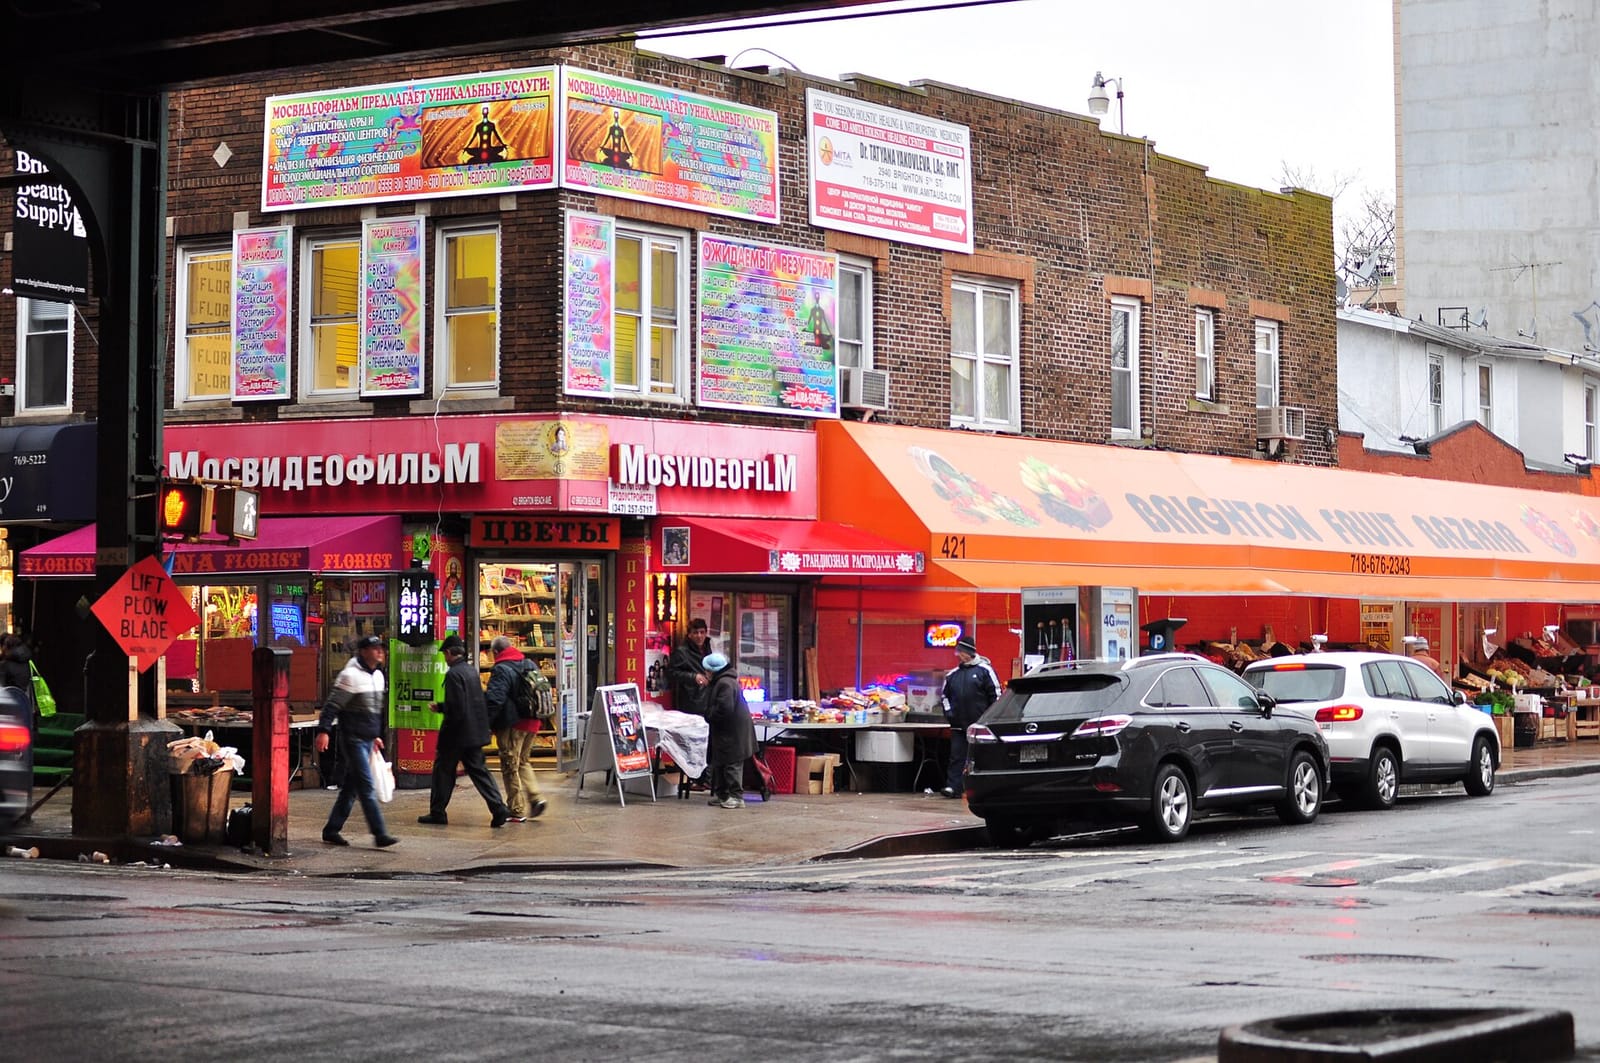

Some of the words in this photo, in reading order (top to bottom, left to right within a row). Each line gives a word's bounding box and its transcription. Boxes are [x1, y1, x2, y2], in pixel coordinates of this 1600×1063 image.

[272, 97, 358, 119] МОСВИДЕОФИЛЬМ
[361, 89, 425, 110] ПРЕДЛАГАЕТ
[429, 81, 501, 103] УНИКАЛЬНЫЕ
[503, 76, 549, 95] УСЛУГИ:
[568, 77, 637, 105] МОСВИДЕОФИЛЬМ
[640, 92, 688, 116] ПРЕДЛАГАЕТ
[690, 103, 740, 127] УНИКАЛЬНЫЕ
[870, 144, 895, 165] TATYANA
[893, 169, 923, 184] BRIGHTON
[16, 197, 73, 231] Supply
[702, 238, 776, 271] ОЖИДАЕМЫЙ
[781, 251, 833, 280] РЕЗУЛЬТАТ
[13, 454, 46, 465] 769-5222
[619, 444, 797, 492] MOSVIDEOFILM
[628, 504, 653, 513] 257-5717
[483, 521, 610, 544] ЦВЕТЫ
[1125, 493, 1324, 542] BRIGHTON
[1318, 508, 1414, 548] FRUIT
[1411, 514, 1532, 553] BAZAAR
[941, 536, 966, 559] 421
[24, 557, 95, 572] FLORIST
[224, 553, 301, 569] FLORIST
[323, 553, 392, 569] FLORIST
[802, 554, 849, 570] ГРАНДИОЗНАЯ
[852, 555, 896, 571] РАСПРОДАЖА
[1350, 554, 1410, 575] 718-676-2343
[131, 572, 165, 593] LIFT
[352, 582, 366, 602] FOR
[124, 596, 168, 616] PLOW
[120, 619, 168, 639] BLADE
[1104, 614, 1115, 627] 4G
[740, 678, 760, 688] TAX
[621, 724, 634, 736] TV
